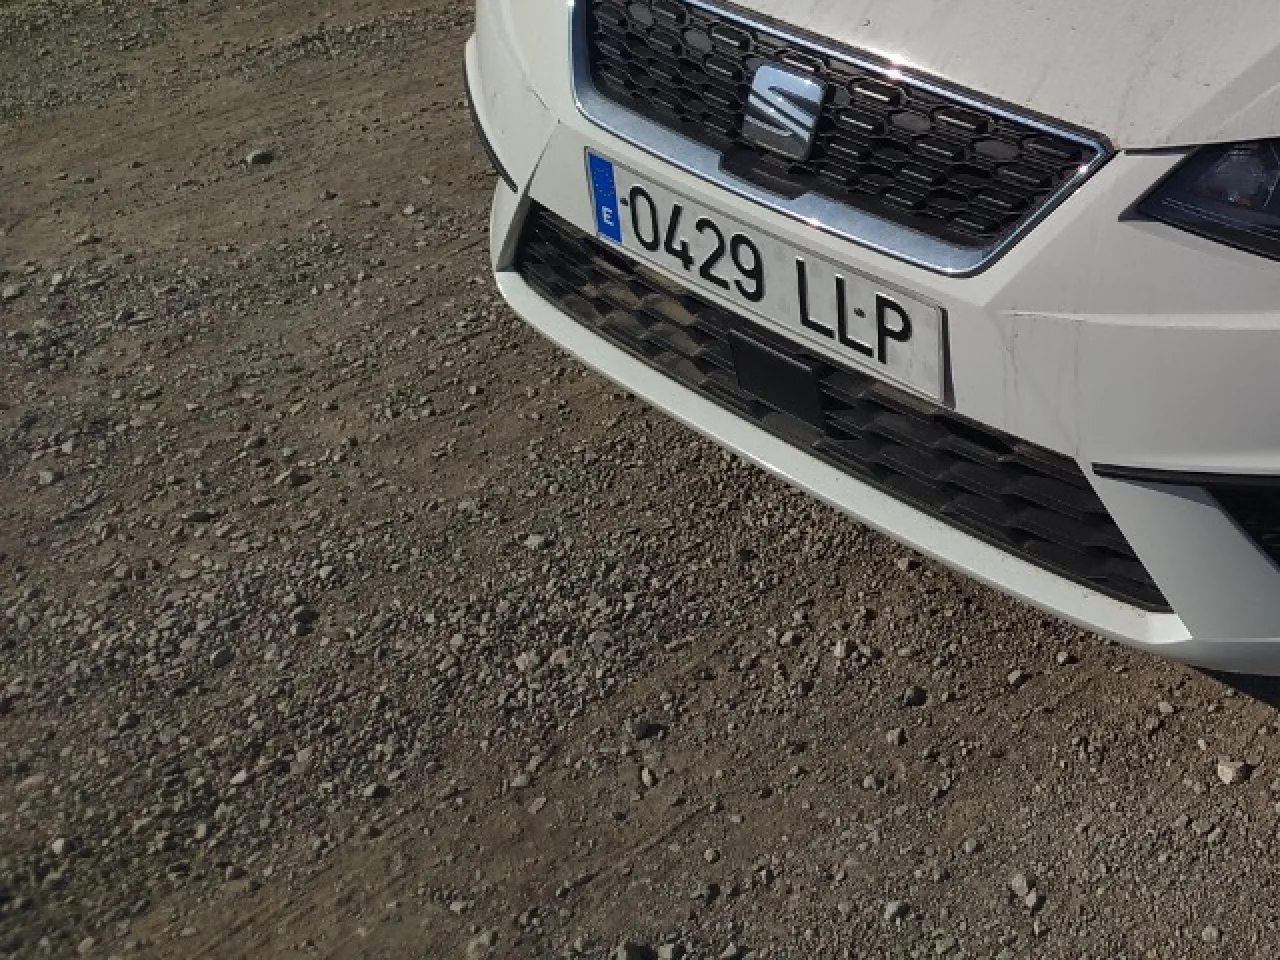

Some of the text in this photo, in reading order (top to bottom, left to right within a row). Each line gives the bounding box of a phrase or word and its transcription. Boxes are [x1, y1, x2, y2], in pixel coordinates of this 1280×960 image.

[601, 205, 615, 227] E
[628, 184, 913, 365] 0429 LLP
